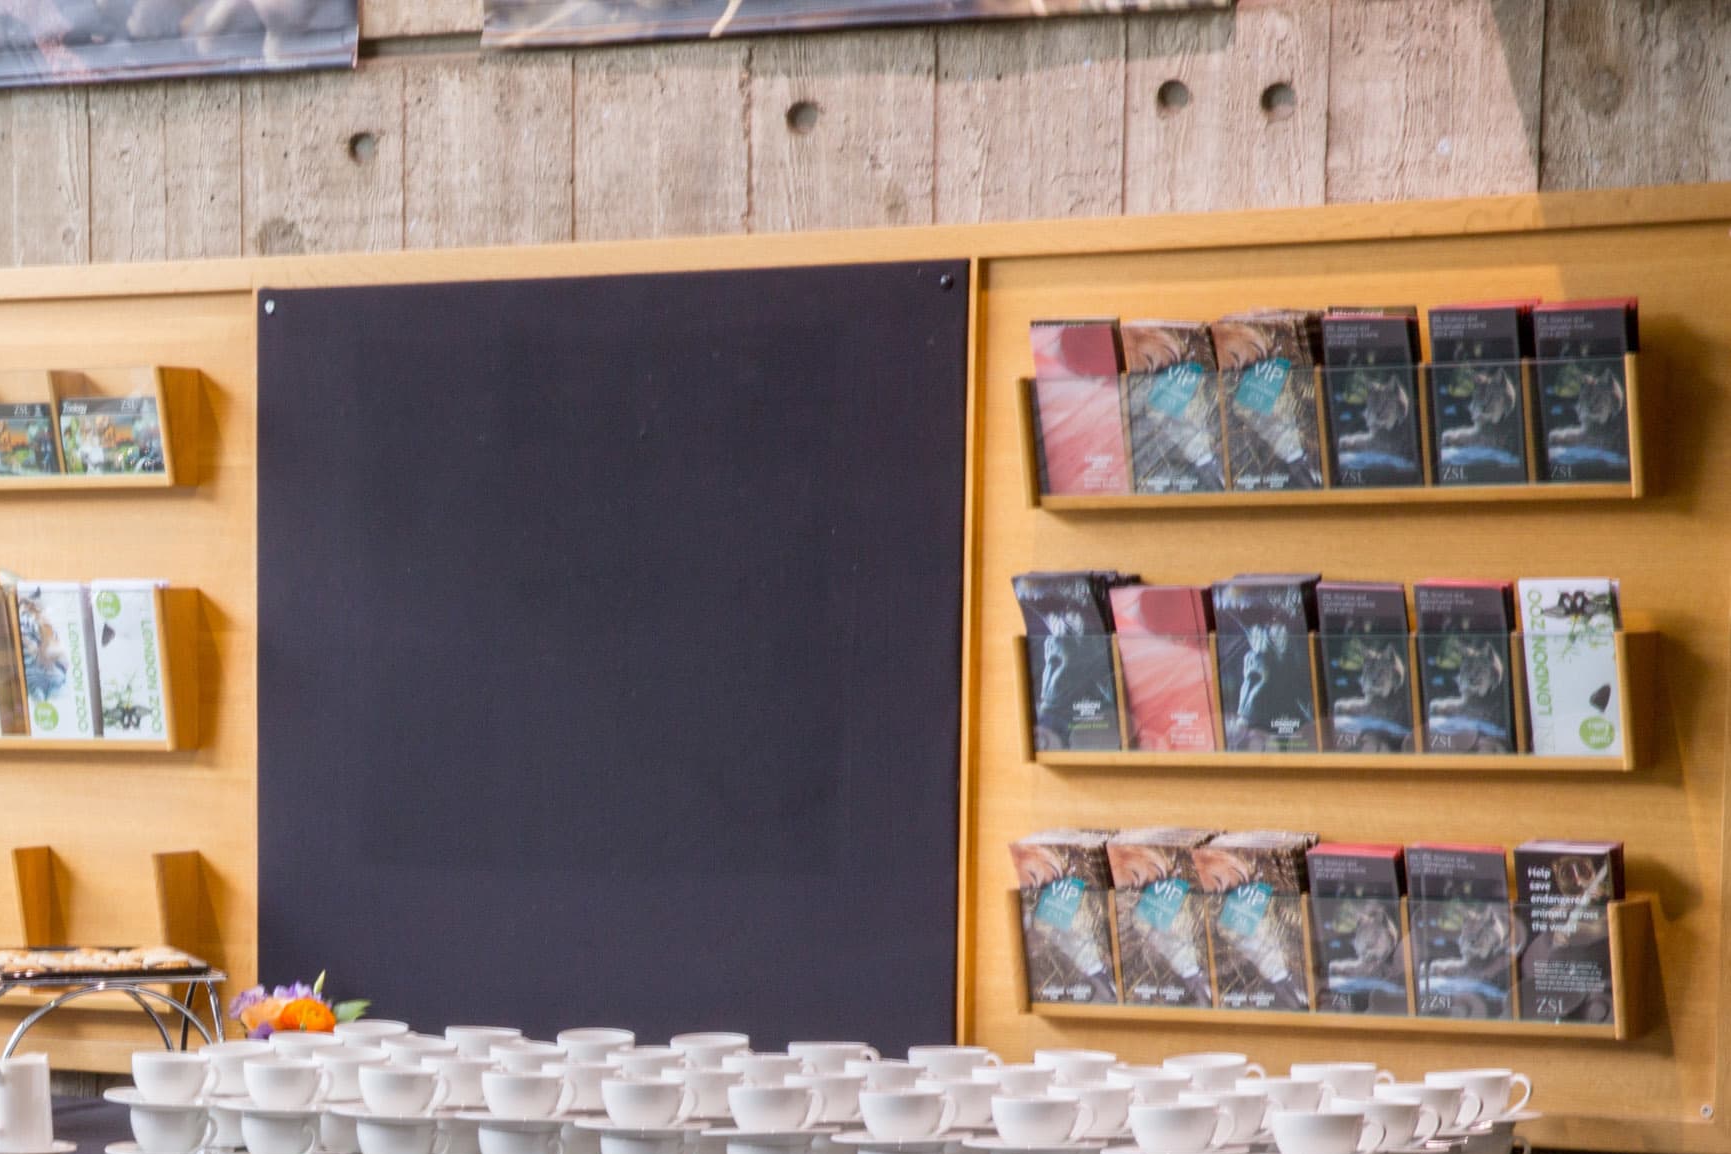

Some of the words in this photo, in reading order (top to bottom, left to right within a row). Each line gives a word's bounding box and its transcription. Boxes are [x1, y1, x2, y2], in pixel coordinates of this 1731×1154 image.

[1442, 465, 1468, 481] ZSL
[1527, 590, 1546, 630] ZOO
[1531, 634, 1553, 716] LONDON
[76, 695, 88, 733] ZOO
[149, 696, 162, 733] ZOO
[1528, 866, 1551, 880] Help
[1529, 881, 1550, 892] save
[1536, 996, 1563, 1014] ZSL
